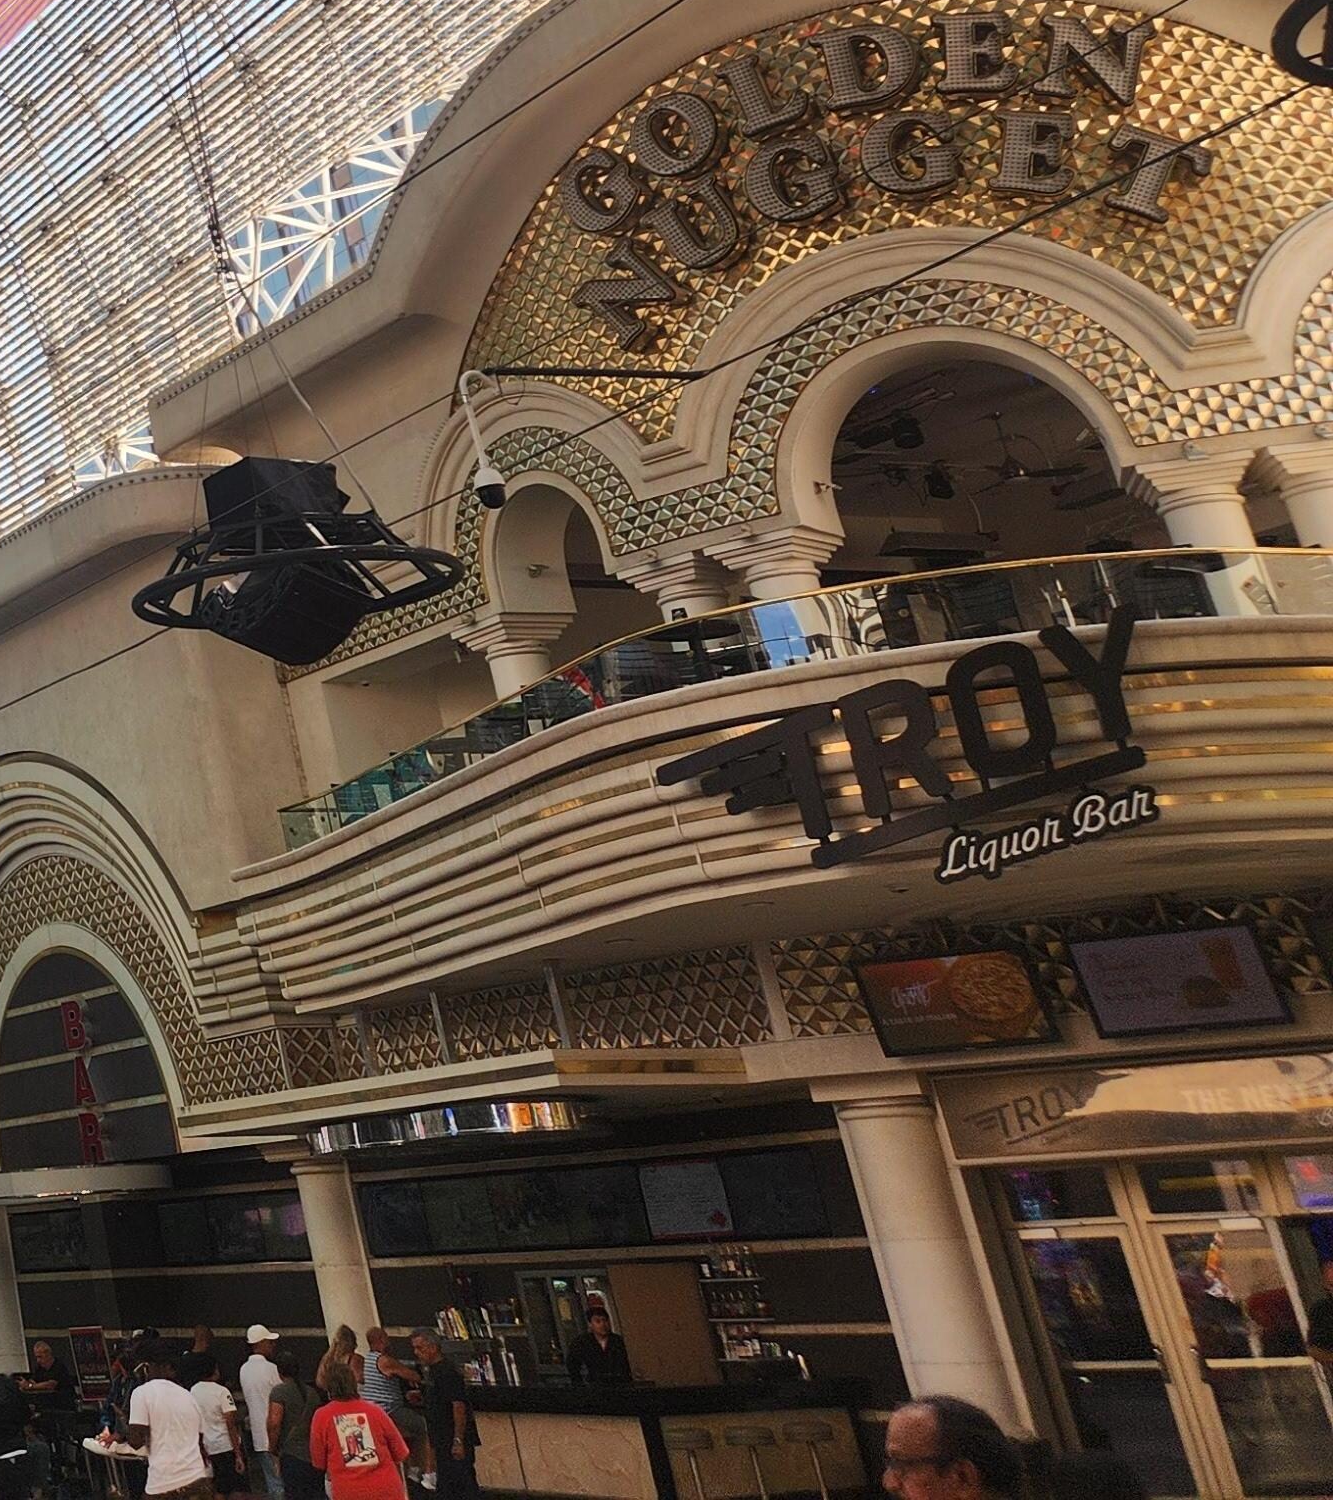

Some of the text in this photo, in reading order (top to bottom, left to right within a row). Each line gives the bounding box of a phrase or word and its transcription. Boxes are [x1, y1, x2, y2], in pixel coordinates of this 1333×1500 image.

[561, 11, 1156, 233] GOLDEN
[573, 109, 1213, 354] NUGGET
[657, 603, 1137, 842] TROY
[940, 789, 1153, 878] Liquor Bar
[61, 1001, 106, 1164] BAR
